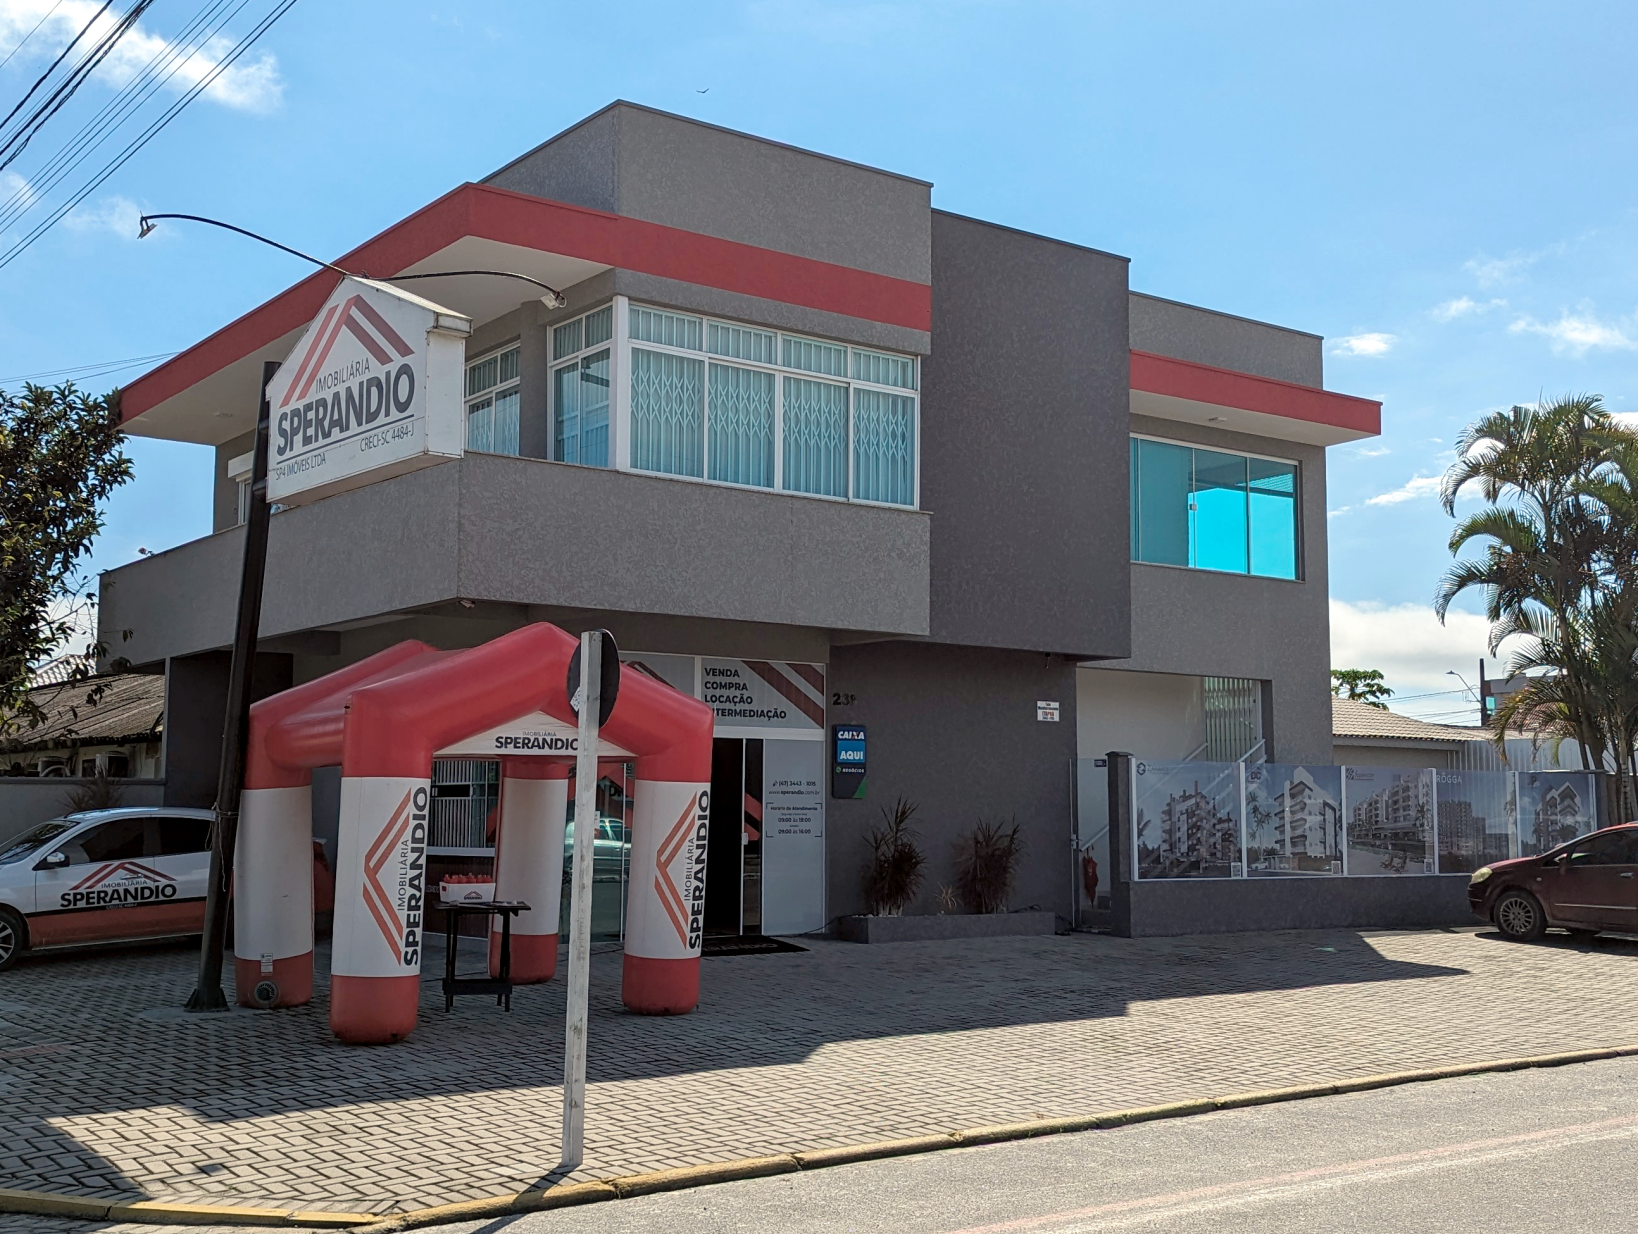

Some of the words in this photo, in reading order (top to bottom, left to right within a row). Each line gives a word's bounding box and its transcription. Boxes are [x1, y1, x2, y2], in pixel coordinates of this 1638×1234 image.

[315, 357, 371, 395] IMOBILIÁRIA
[276, 363, 415, 457] SPERANDIO
[360, 430, 390, 452] CRECI-SC
[391, 422, 414, 442] 4484-J
[286, 457, 310, 477] IMÓVEIS
[311, 452, 326, 469] LTDA
[704, 667, 740, 678] VENDA
[704, 681, 748, 692] COMPRA
[704, 693, 753, 706] LOCAÇÃO
[712, 707, 787, 721] TERMEDIAÇÃO
[837, 731, 865, 740] CAIXA
[839, 750, 864, 760] AQUI
[1436, 772, 1463, 784] RÔGGA
[397, 839, 409, 911] IMOBILIÁRIA
[403, 786, 428, 966] SPERANDIO
[684, 837, 695, 902] IMOBILIÁRIA
[688, 789, 709, 950] SPERANDIO
[60, 883, 177, 908] SPERANDIO
